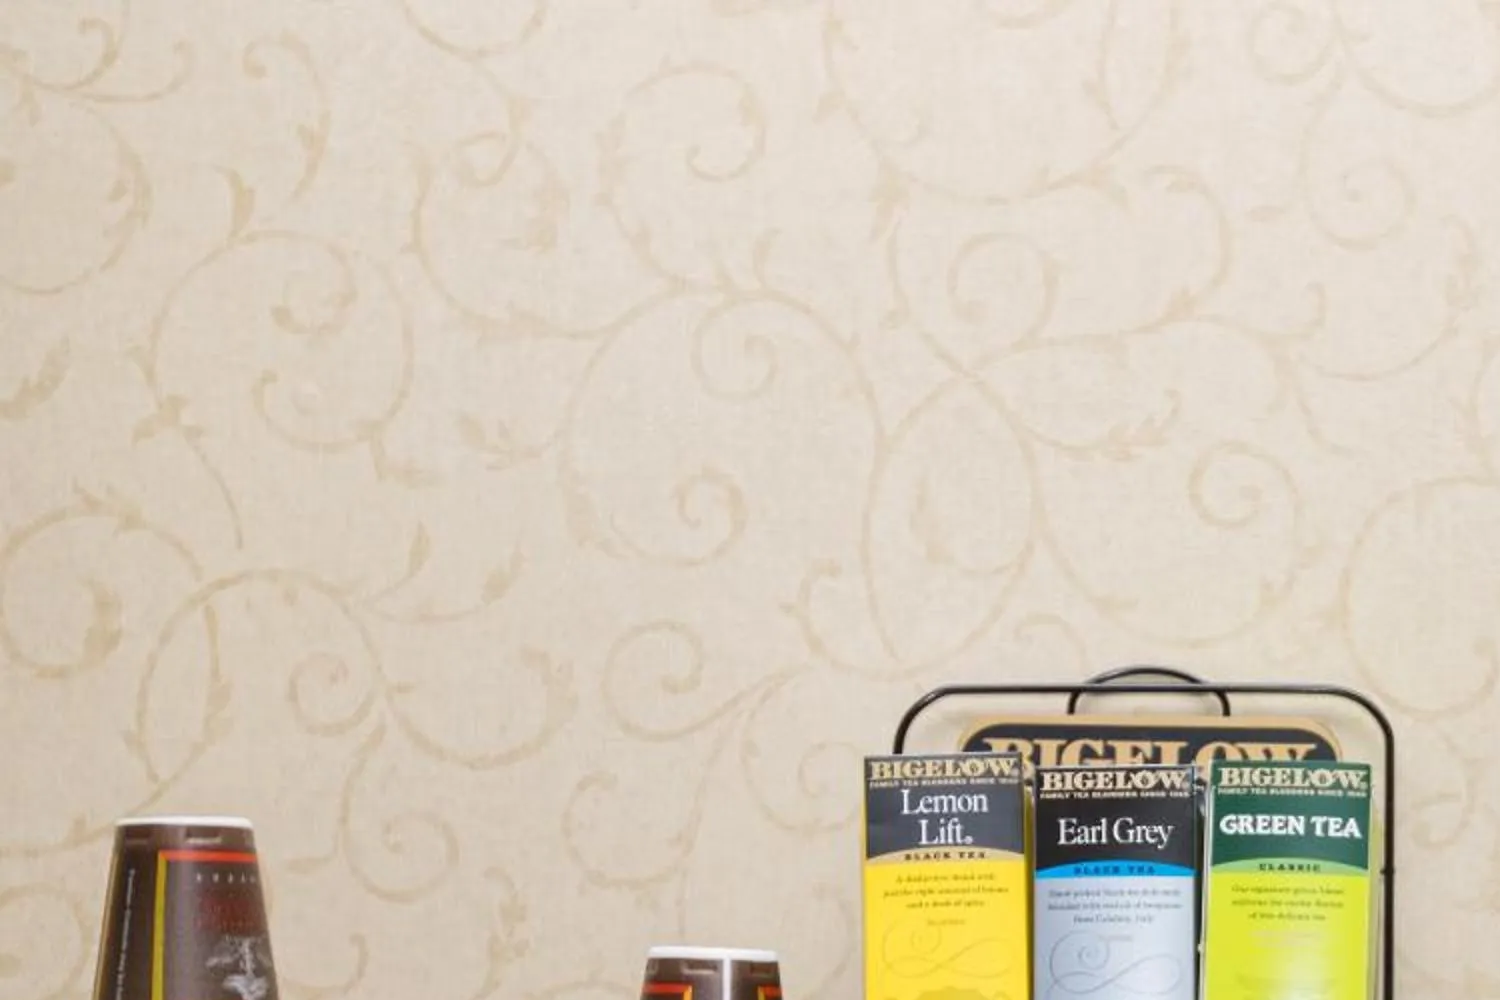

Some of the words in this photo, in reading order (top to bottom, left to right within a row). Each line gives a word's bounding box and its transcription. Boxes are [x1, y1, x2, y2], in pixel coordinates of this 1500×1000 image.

[870, 757, 1016, 779] BIGELOW
[1218, 767, 1367, 789] BIGELOW
[1040, 770, 1188, 791] BIGELOW
[901, 788, 989, 815] Lemon
[1057, 817, 1108, 845] Earl
[1112, 817, 1175, 850] Grey
[1219, 813, 1306, 836] GREEN
[1310, 815, 1363, 839] TEA
[904, 851, 952, 861] BLACK
[958, 851, 987, 860] TEA
[1128, 865, 1156, 875] TEA
[1258, 863, 1322, 873] CLASSIC
